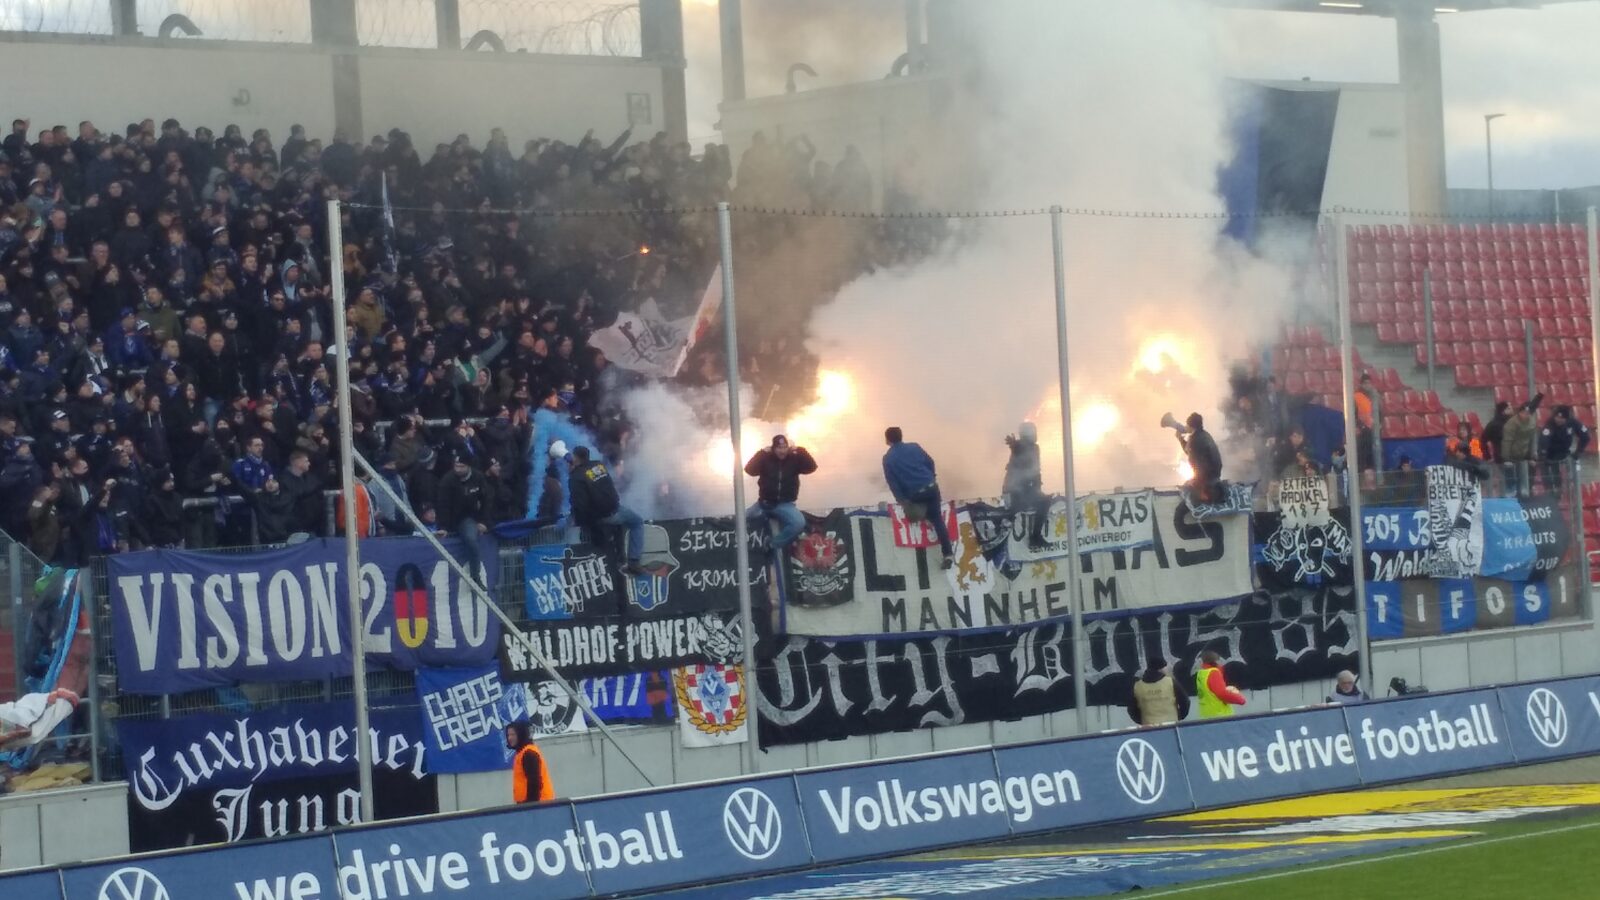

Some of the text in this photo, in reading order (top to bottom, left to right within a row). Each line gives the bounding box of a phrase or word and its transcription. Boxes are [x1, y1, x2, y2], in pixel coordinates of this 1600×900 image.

[1281, 489, 1327, 504] RADIKAL
[1289, 502, 1320, 518] 187
[1491, 506, 1552, 523] WALDHOF
[1364, 514, 1399, 543] 305
[118, 559, 488, 672] VISION 2010
[423, 671, 503, 723] CHAOS
[433, 703, 503, 751] CREW
[1201, 703, 1498, 782] we drive football
[818, 767, 1081, 834] Volkswagen
[337, 843, 471, 900] drive
[480, 810, 684, 885] football
